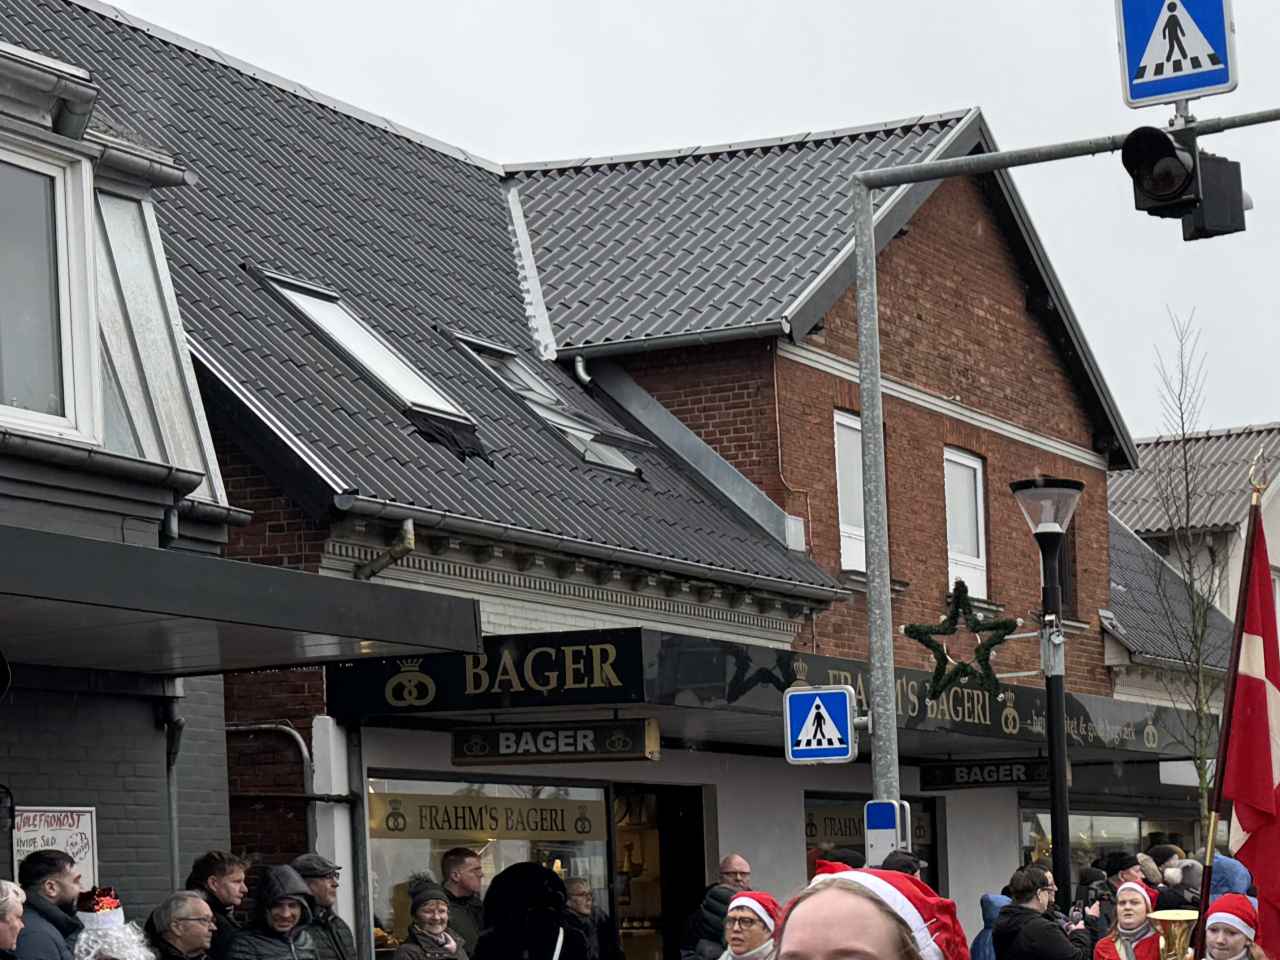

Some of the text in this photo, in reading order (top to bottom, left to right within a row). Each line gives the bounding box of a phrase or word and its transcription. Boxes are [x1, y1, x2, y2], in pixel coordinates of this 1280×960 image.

[464, 642, 623, 696] BAGER
[500, 730, 595, 753] BAGER
[954, 764, 1027, 783] BAGER
[418, 803, 568, 833] FRAHM'S BAGERI
